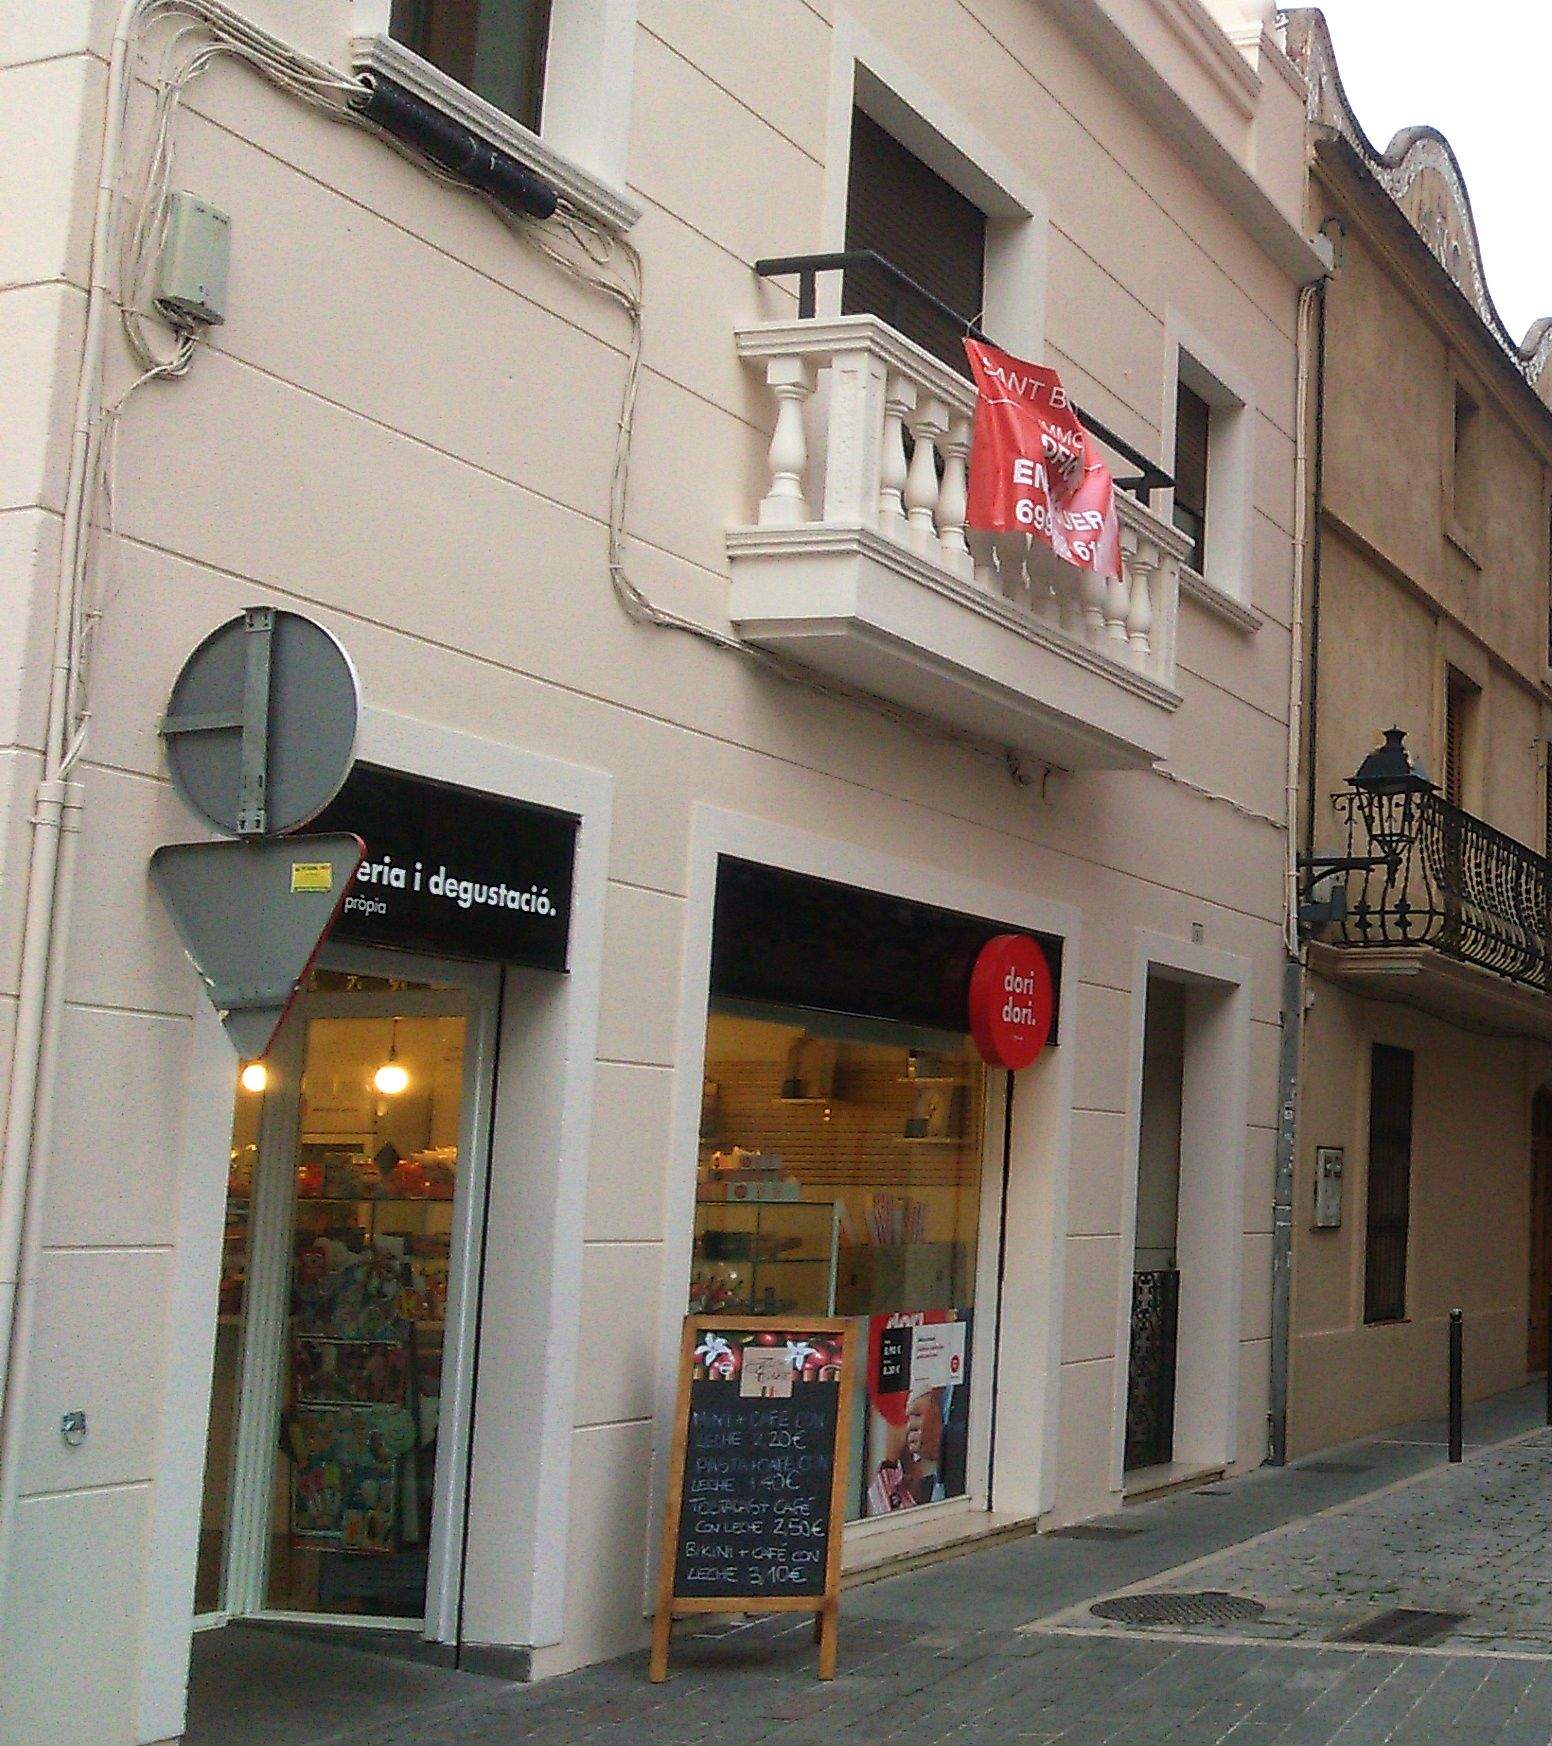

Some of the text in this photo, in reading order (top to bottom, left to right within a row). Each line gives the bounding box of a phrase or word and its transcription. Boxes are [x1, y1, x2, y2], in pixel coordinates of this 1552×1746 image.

[356, 855, 557, 917] eria i degustació.
[343, 893, 387, 917] pròpia
[1004, 966, 1035, 995] dori
[1002, 996, 1037, 1026] dori.
[686, 1566, 738, 1583] LECHE
